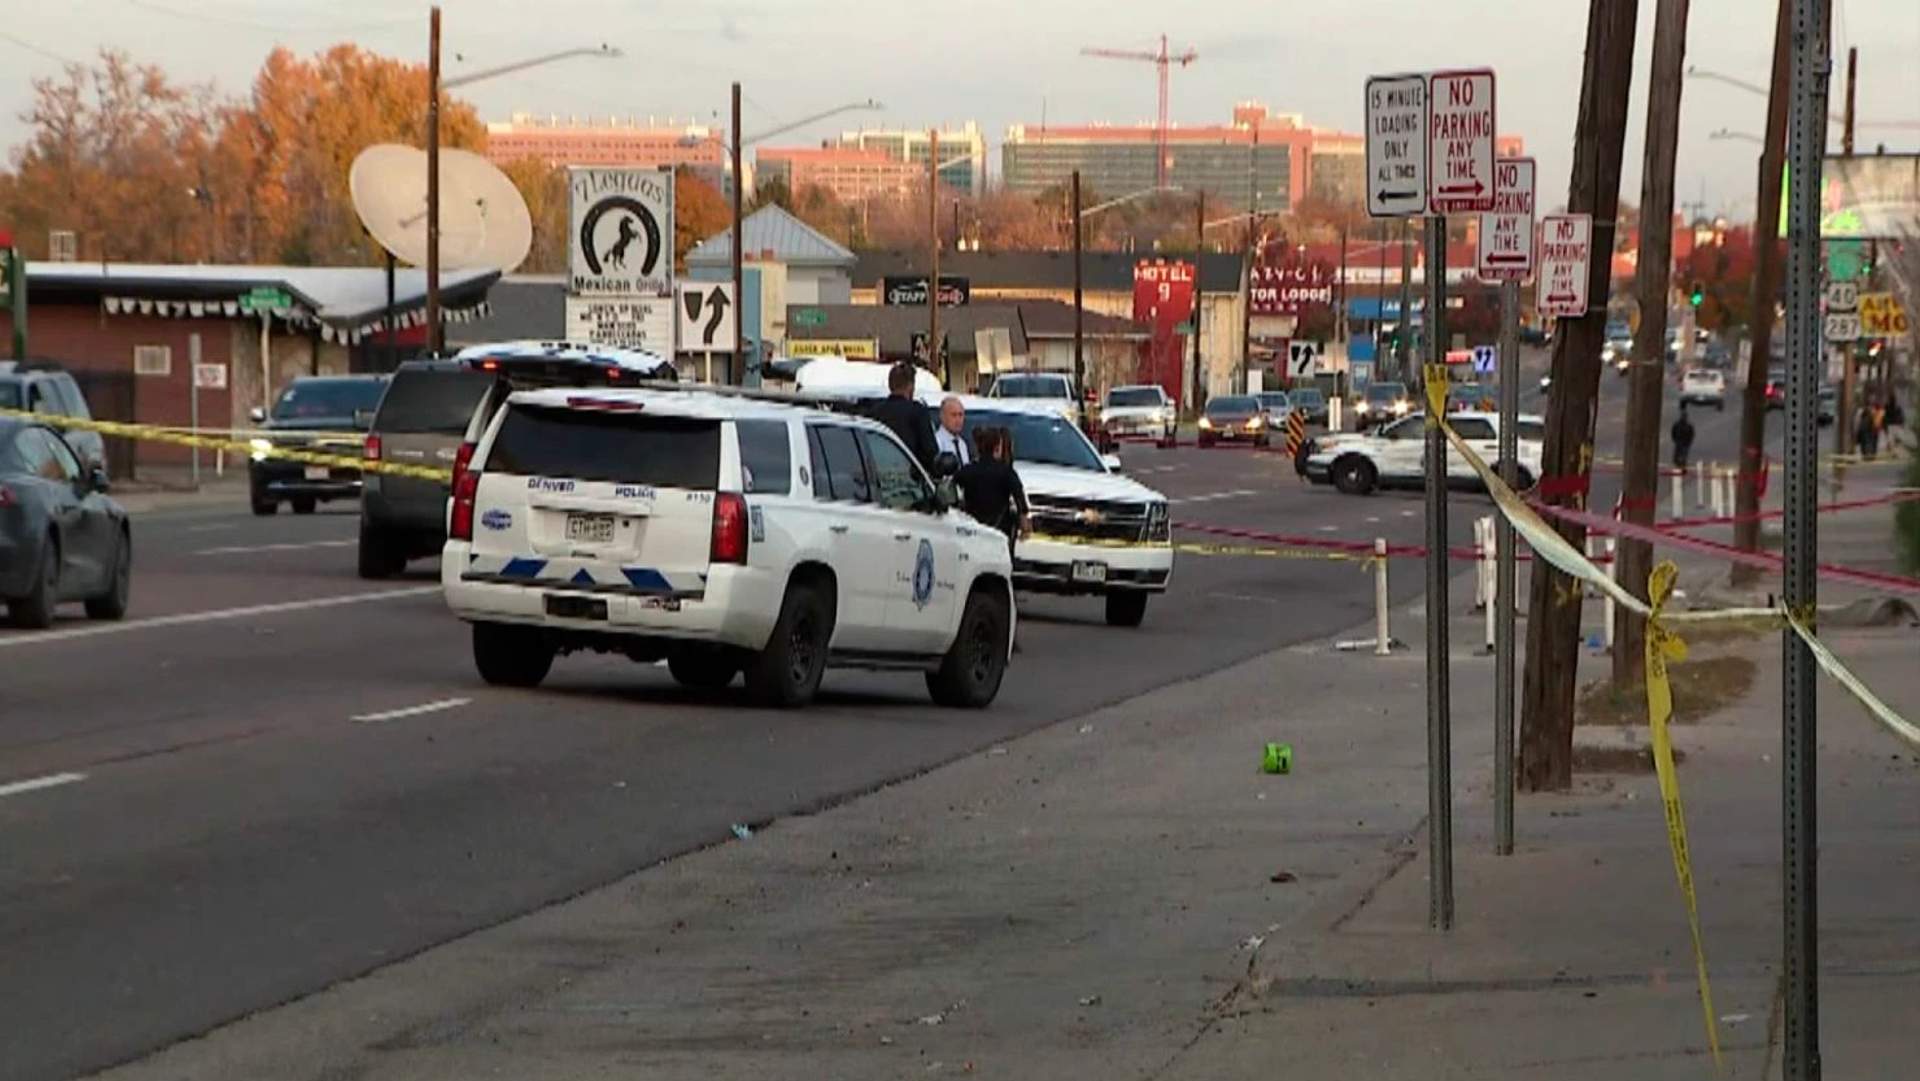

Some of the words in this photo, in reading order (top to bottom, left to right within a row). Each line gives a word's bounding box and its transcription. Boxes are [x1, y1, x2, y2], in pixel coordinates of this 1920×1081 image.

[1387, 86, 1422, 108] MINUTE
[1449, 79, 1474, 106] NO
[1375, 113, 1417, 135] LOADING
[1434, 110, 1490, 139] PARKING
[1384, 141, 1408, 160] ONLY
[1447, 141, 1473, 157] ANY
[1446, 160, 1476, 178] TIME
[1498, 165, 1518, 188] NO
[1496, 191, 1531, 215] RKING
[1495, 217, 1517, 231] ANY
[1556, 222, 1575, 240] NO
[1493, 234, 1519, 250] TIME
[1543, 244, 1586, 261] PARKING
[1134, 265, 1192, 281] MOTEL
[1554, 264, 1573, 276] ANY
[574, 275, 631, 291] Mexican
[1551, 278, 1573, 291] TIME
[1281, 287, 1327, 301] LODGE
[528, 478, 575, 493] DENVER
